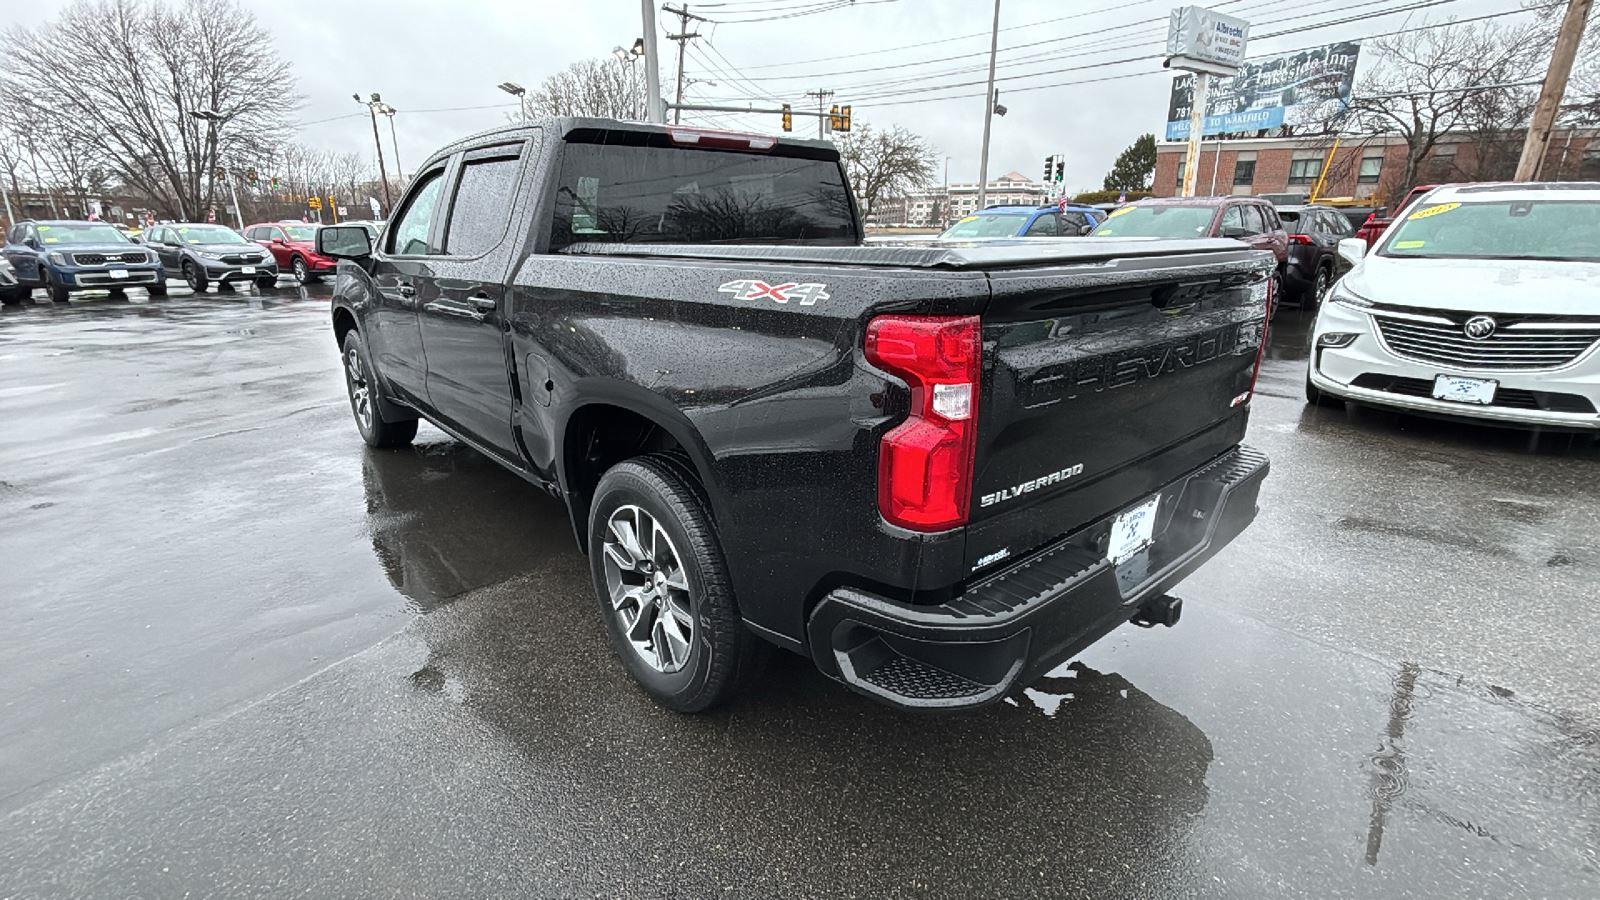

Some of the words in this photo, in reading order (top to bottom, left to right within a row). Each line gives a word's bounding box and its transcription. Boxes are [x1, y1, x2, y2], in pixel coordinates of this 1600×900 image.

[1324, 45, 1349, 68] Inn
[1210, 117, 1221, 127] TO
[1224, 111, 1270, 125] WAKEFIELD
[980, 463, 1085, 508] SILVERADO
